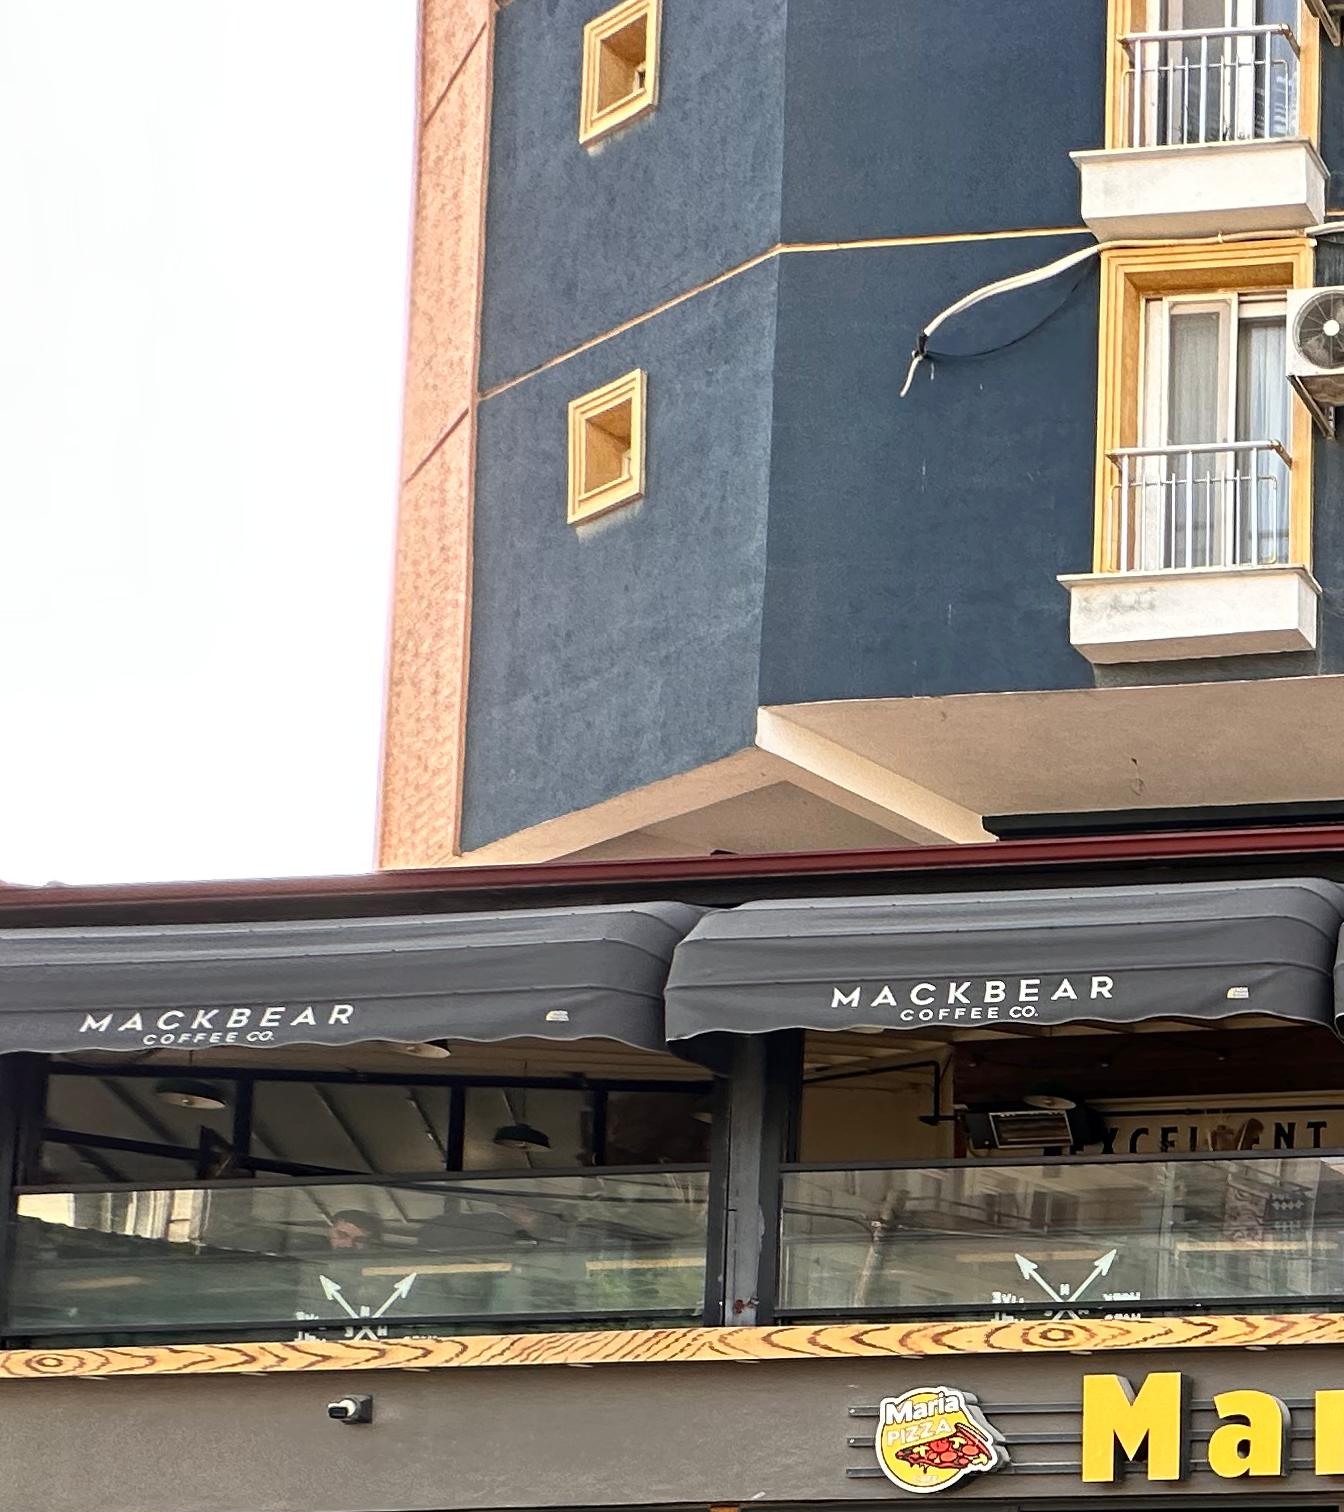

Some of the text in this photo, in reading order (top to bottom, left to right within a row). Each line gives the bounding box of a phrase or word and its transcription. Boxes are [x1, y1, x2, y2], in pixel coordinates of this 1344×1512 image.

[831, 976, 1114, 1008] MACKBEAR
[79, 1004, 354, 1032] MACKBEAR
[900, 1006, 1000, 1021] COFFEE
[142, 1031, 239, 1045] COFFEE
[885, 1391, 961, 1425] Maria
[887, 1418, 952, 1446] PIZZA
